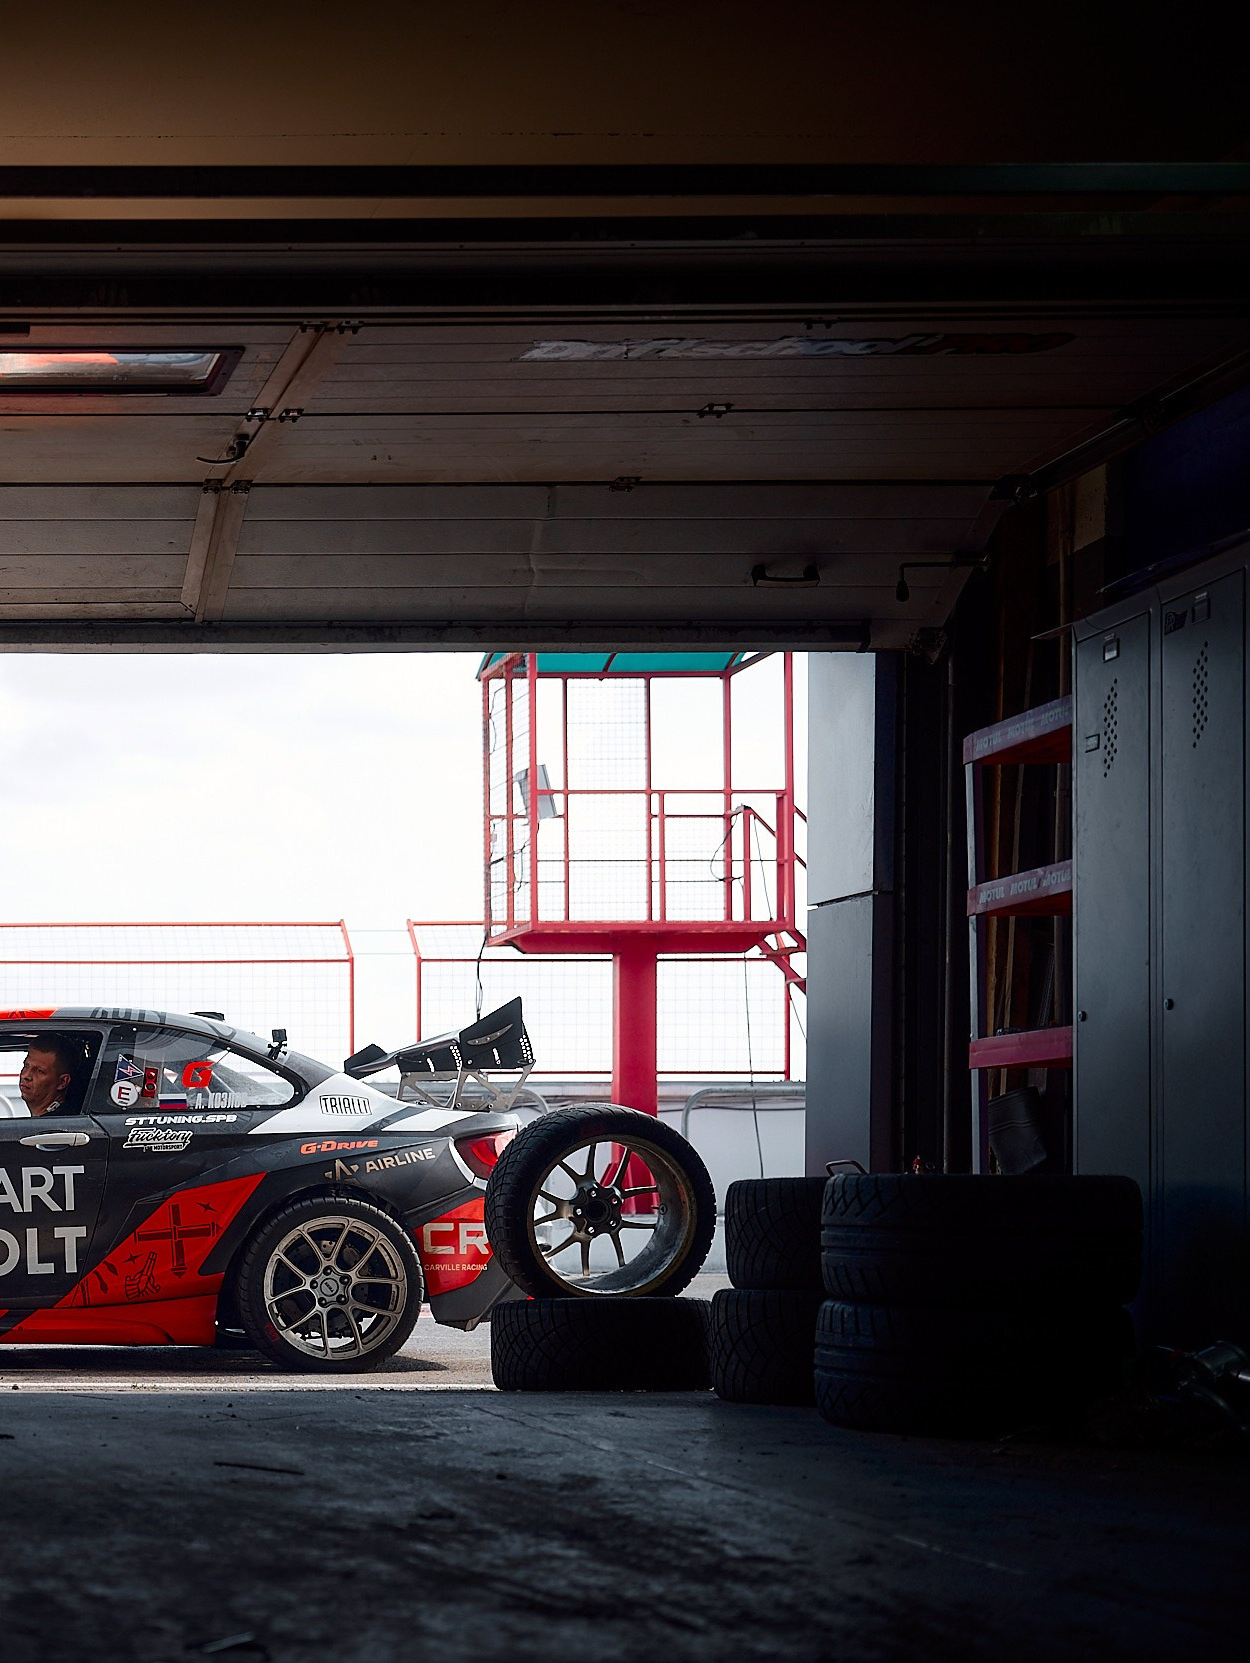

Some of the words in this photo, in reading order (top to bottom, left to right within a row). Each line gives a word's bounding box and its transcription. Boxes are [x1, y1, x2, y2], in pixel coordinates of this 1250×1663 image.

[979, 886, 1005, 905] MOTUL
[1010, 877, 1038, 896] MOTUL
[322, 1097, 369, 1114] TRIALLI
[125, 1114, 238, 1126] STTUNING.SPB
[365, 1148, 436, 1173] AIRLINE
[422, 1222, 490, 1255] CR
[423, 1263, 460, 1271] CARVILLE
[461, 1263, 488, 1271] RACING
